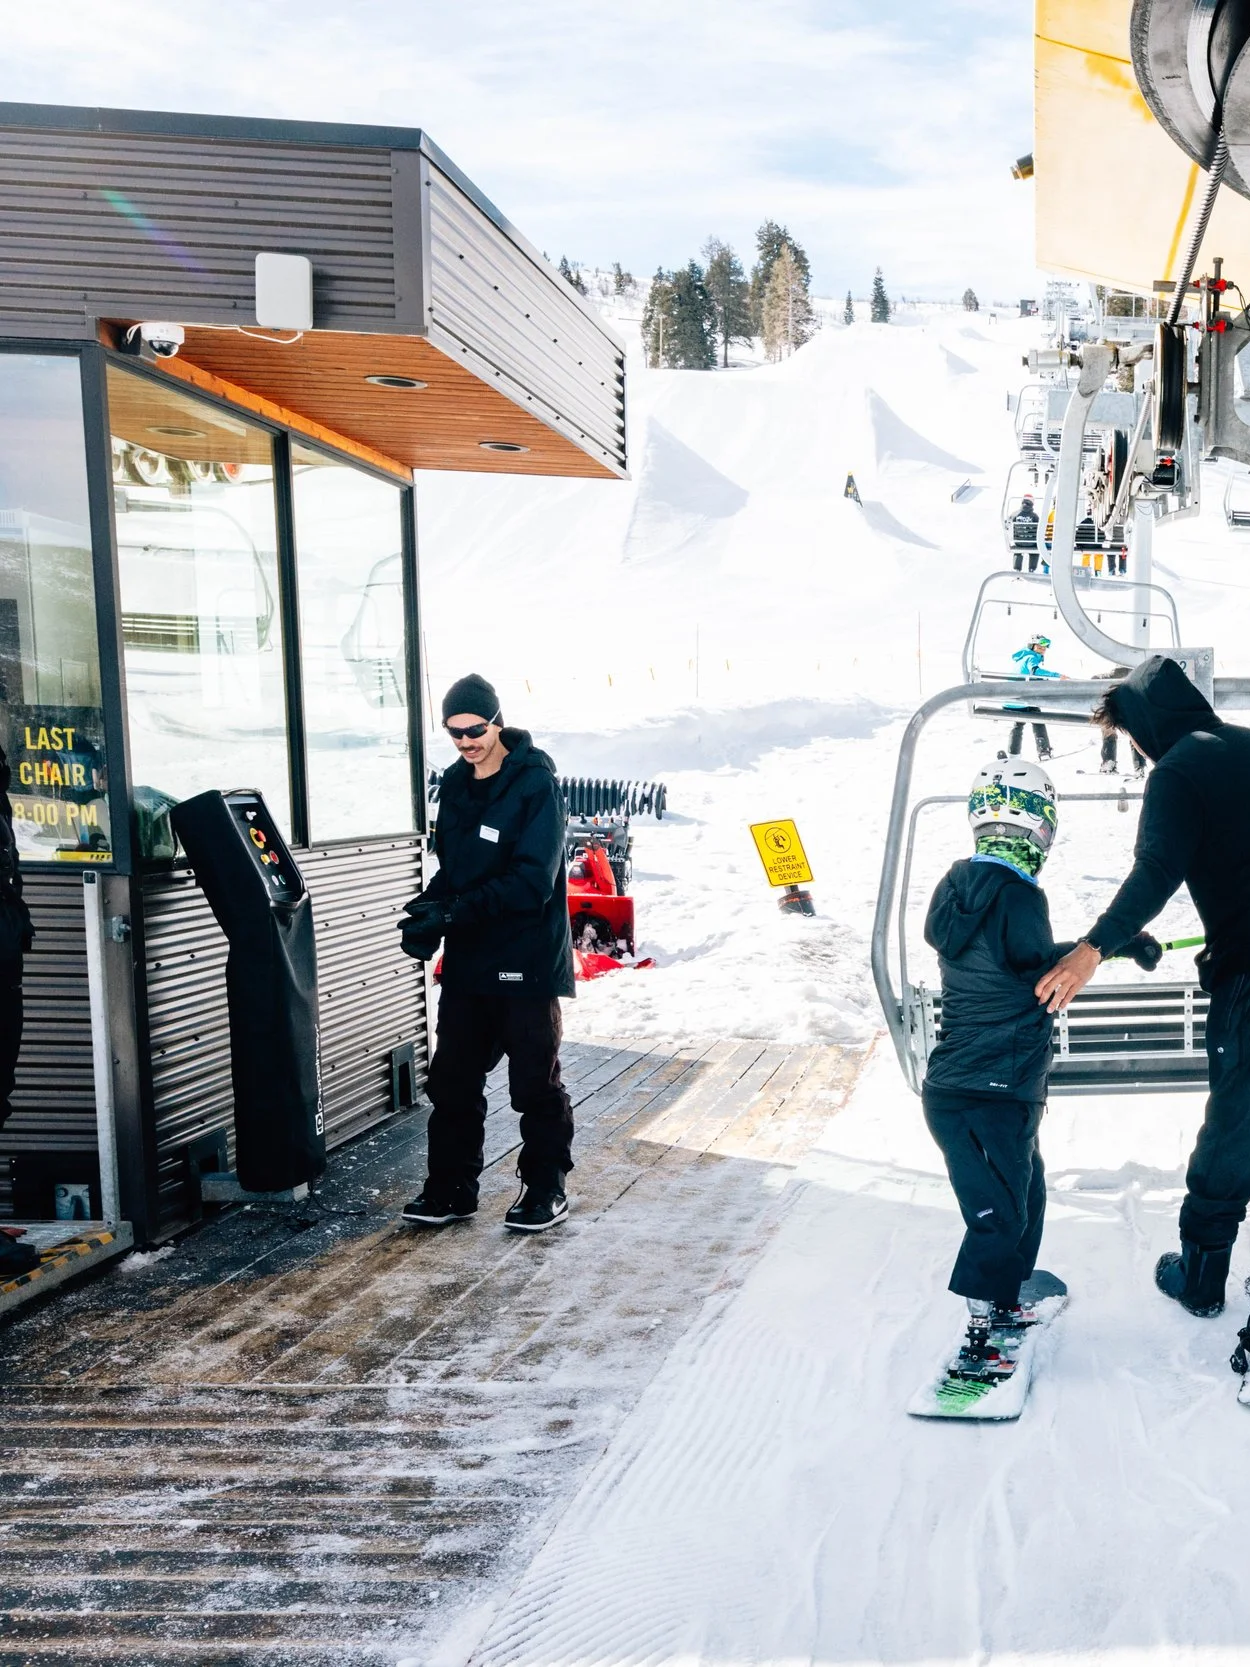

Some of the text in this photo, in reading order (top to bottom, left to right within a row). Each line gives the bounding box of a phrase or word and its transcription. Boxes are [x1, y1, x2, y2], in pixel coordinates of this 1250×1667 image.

[24, 726, 76, 751] LAST
[19, 761, 87, 786] CHAIR
[66, 803, 98, 827] PM
[768, 861, 805, 873] RESTRAINT
[772, 854, 797, 864] LOWER
[778, 871, 803, 881] DEVICE
